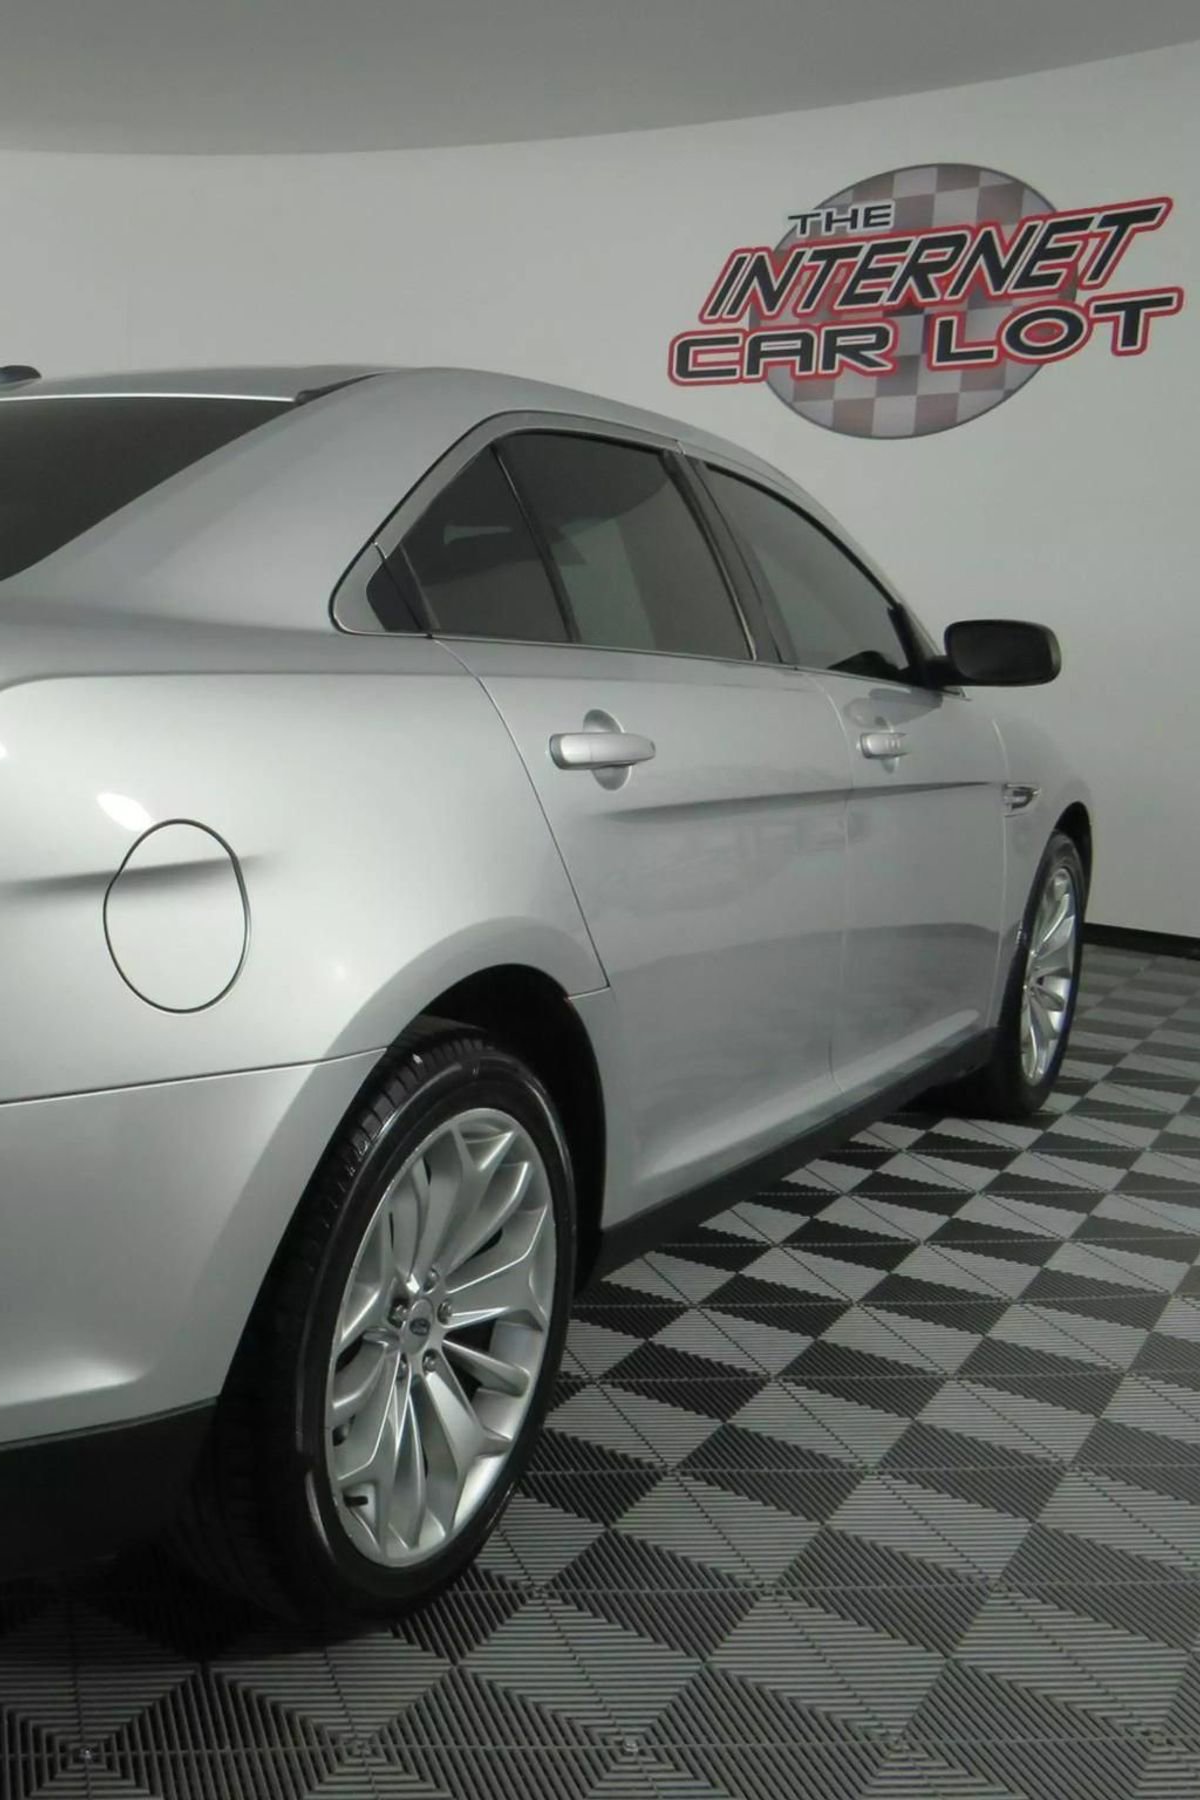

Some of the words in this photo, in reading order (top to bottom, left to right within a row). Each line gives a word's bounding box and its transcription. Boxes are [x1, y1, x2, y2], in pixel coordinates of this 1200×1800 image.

[703, 200, 1169, 320] INTERNET
[788, 203, 894, 235] THE
[671, 321, 894, 382] CAR
[931, 291, 1179, 364] LOT
